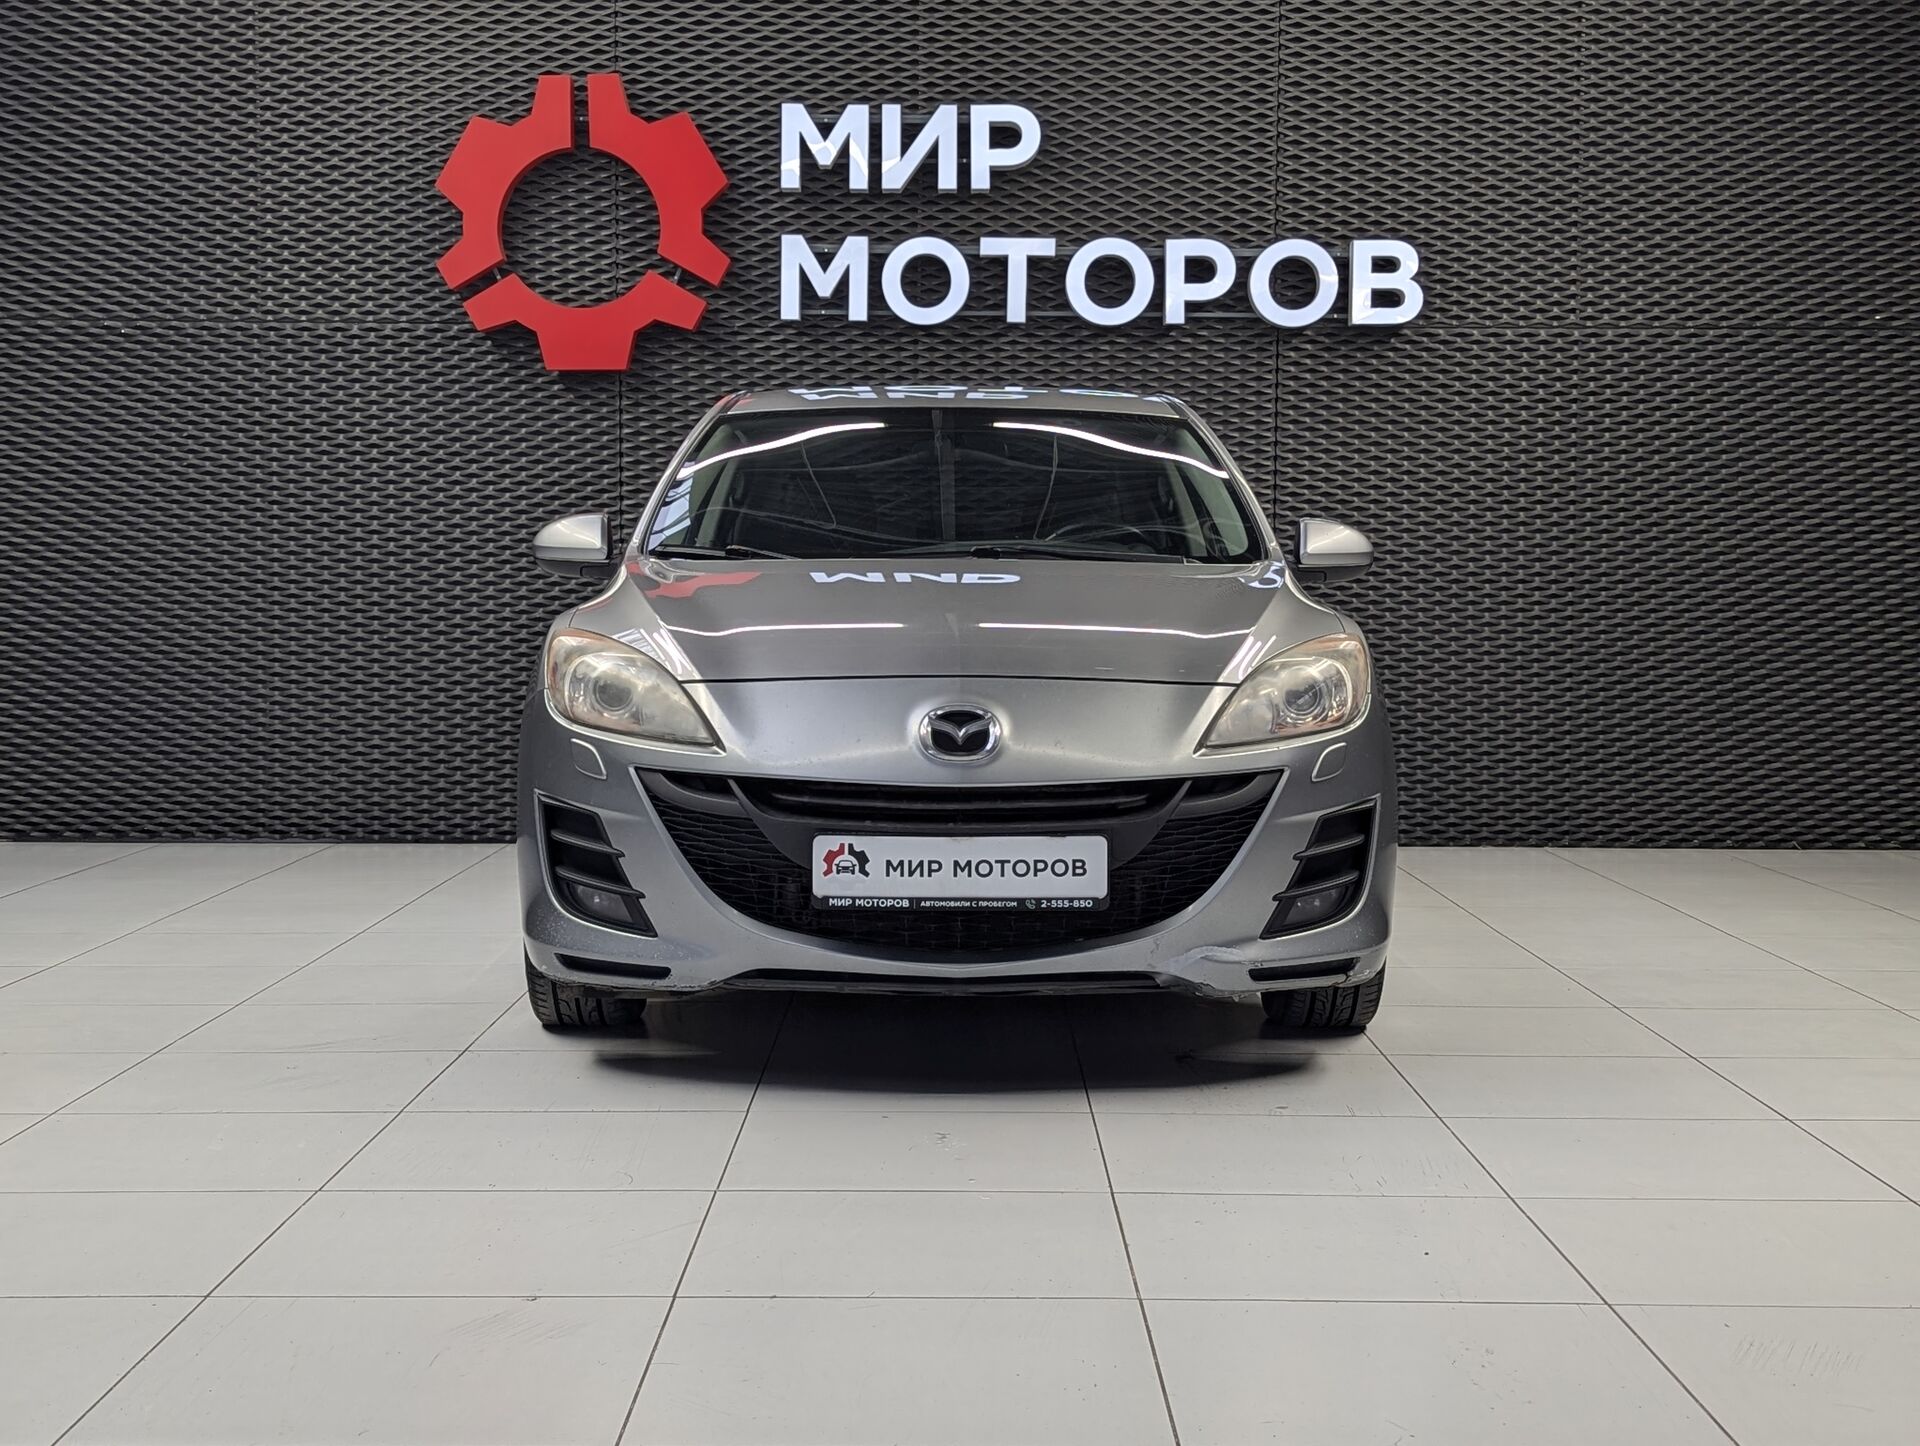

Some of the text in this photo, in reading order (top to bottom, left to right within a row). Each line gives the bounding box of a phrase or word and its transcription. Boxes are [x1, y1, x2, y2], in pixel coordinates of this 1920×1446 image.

[780, 103, 1042, 194] МИР
[780, 234, 1424, 327] МОТОРОВ
[885, 858, 1088, 878] МИР МОТОРОВ
[828, 898, 1094, 908] МИР МОТОРОВ АВТОМОБИЛИ С ПРОБЕГОМ 2-555-850
